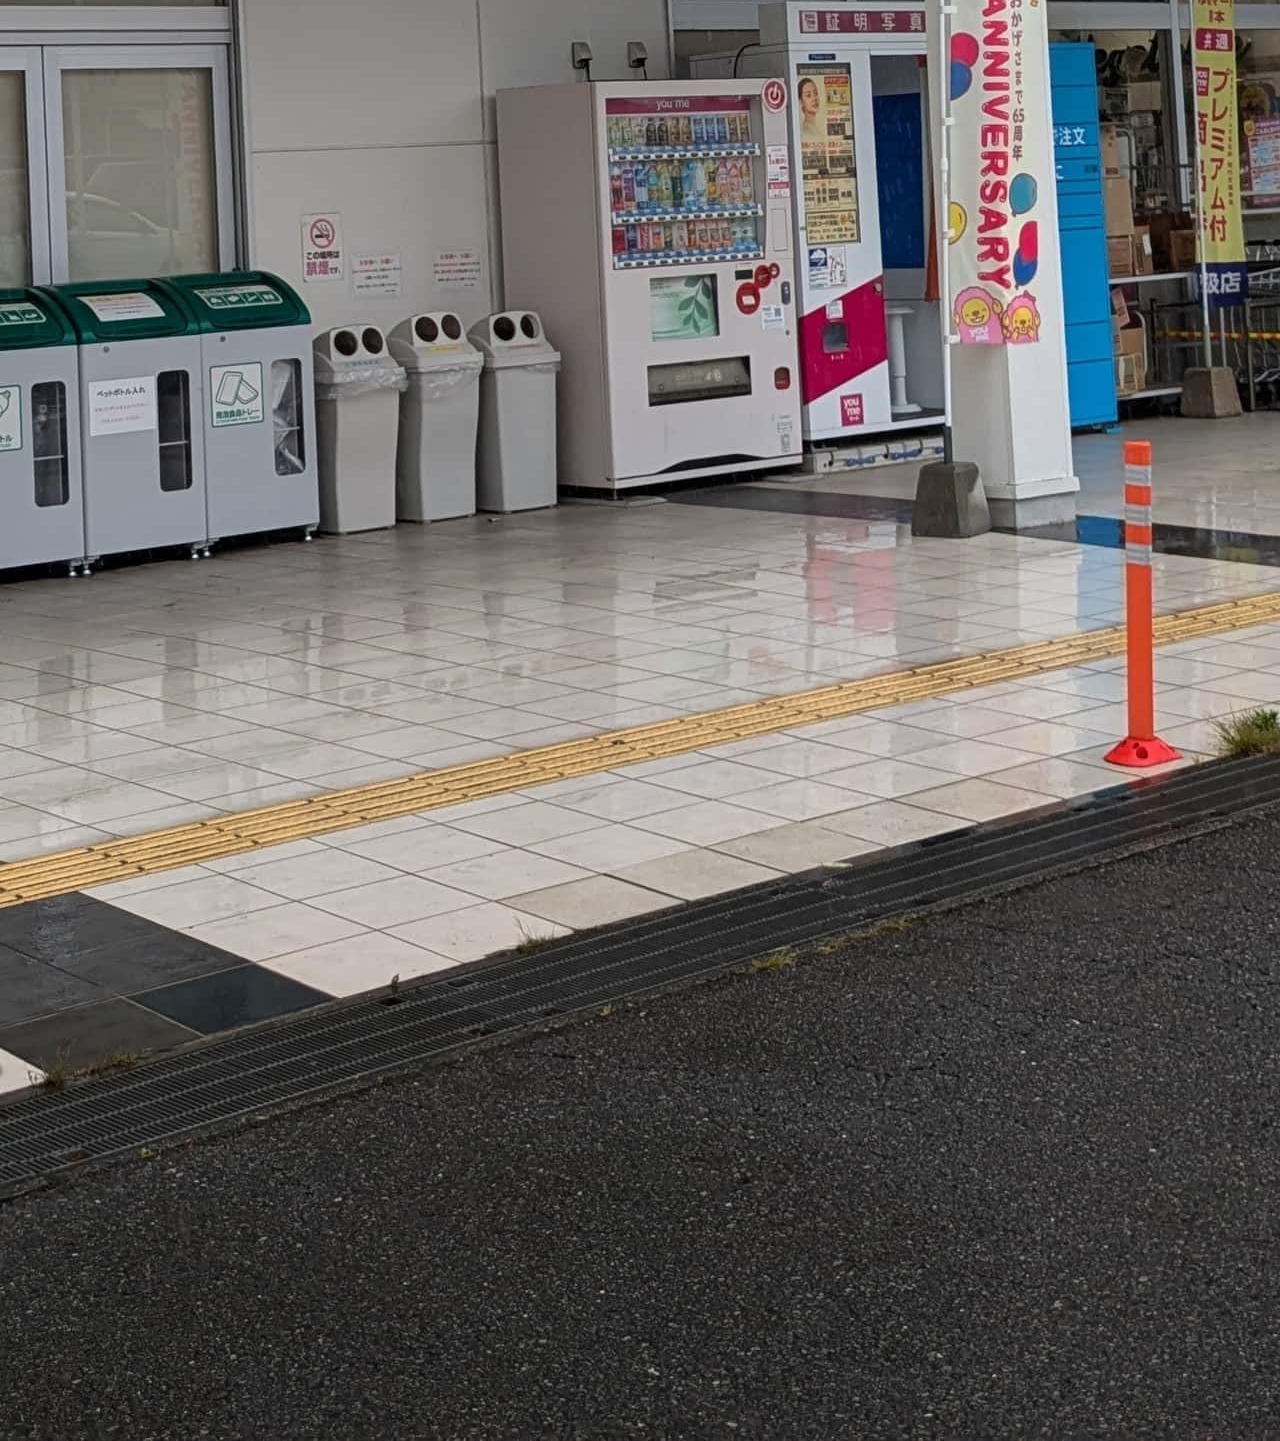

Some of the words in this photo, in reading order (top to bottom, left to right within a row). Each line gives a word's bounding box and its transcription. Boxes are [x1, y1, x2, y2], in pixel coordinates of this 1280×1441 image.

[825, 12, 922, 31] 証明写真
[1209, 68, 1232, 242] プレミアム付
